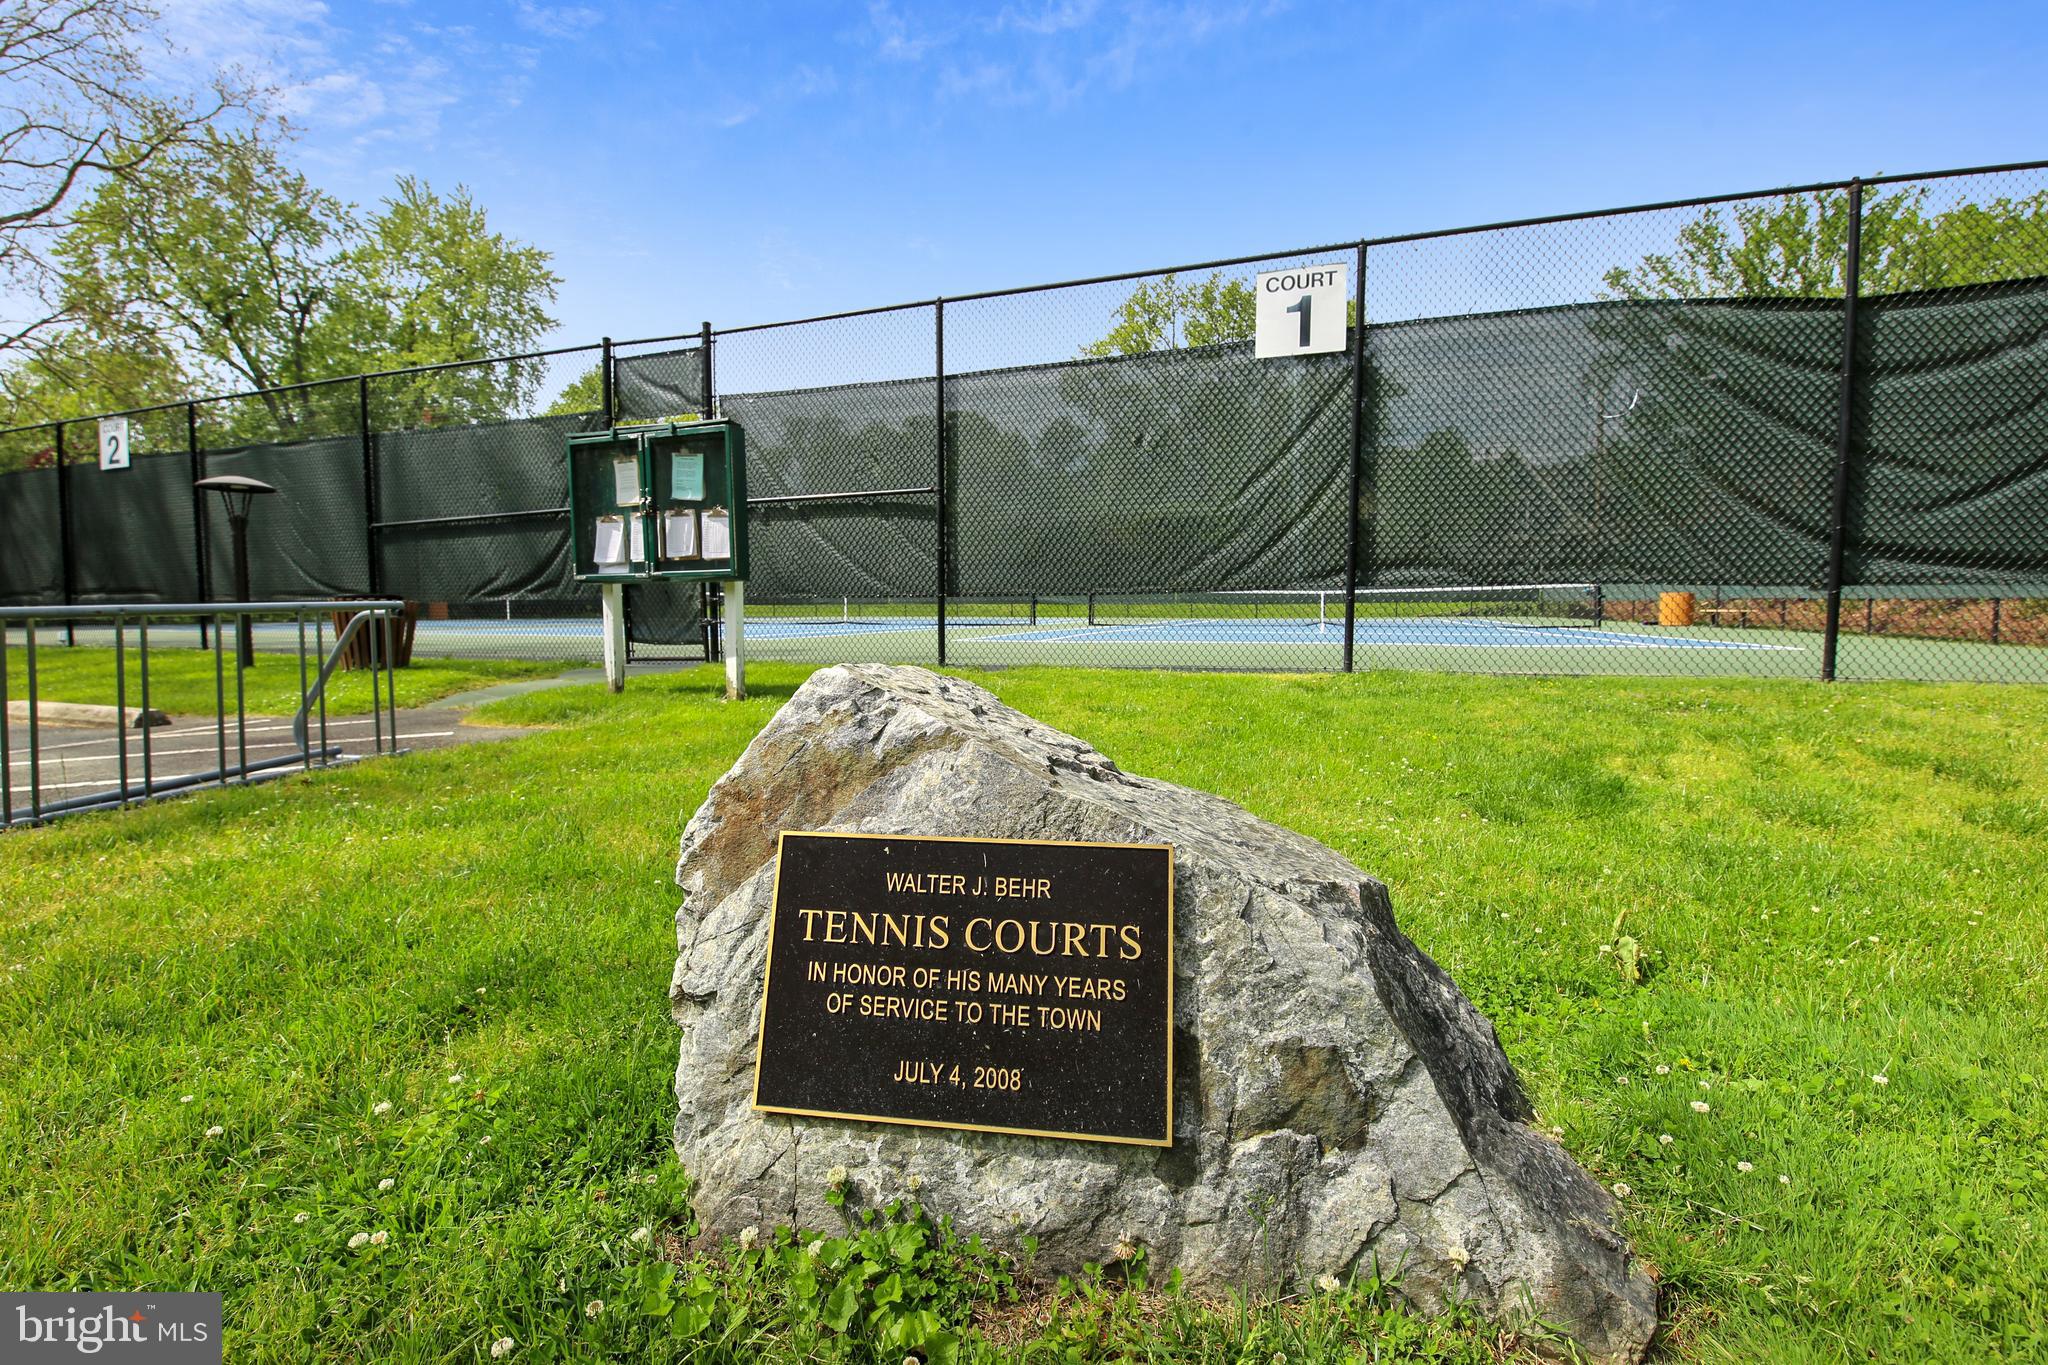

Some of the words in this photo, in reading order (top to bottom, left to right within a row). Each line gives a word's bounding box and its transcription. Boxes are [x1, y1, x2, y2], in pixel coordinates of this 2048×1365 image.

[1266, 271, 1337, 292] COURT
[1287, 295, 1312, 347] 1
[108, 435, 120, 464] 2
[887, 873, 964, 897] WALTER
[972, 876, 987, 897] J.
[995, 877, 1051, 899] BEHR
[799, 909, 950, 949] TENNIS
[965, 917, 1142, 960] COURTS
[808, 961, 826, 982] IN
[833, 963, 905, 987] HONOR
[914, 968, 941, 988] OF
[947, 969, 980, 992] HIS
[989, 973, 1048, 996] MANY
[1054, 976, 1126, 1000] YEARS
[827, 993, 853, 1013] OF
[860, 995, 947, 1022] SERVICE
[956, 1001, 983, 1023] TO
[992, 1004, 1030, 1026] THE
[1037, 1007, 1101, 1031] TOWN
[894, 1061, 944, 1084] JULY
[950, 1064, 966, 1088] 4,
[975, 1067, 1022, 1091] 2008
